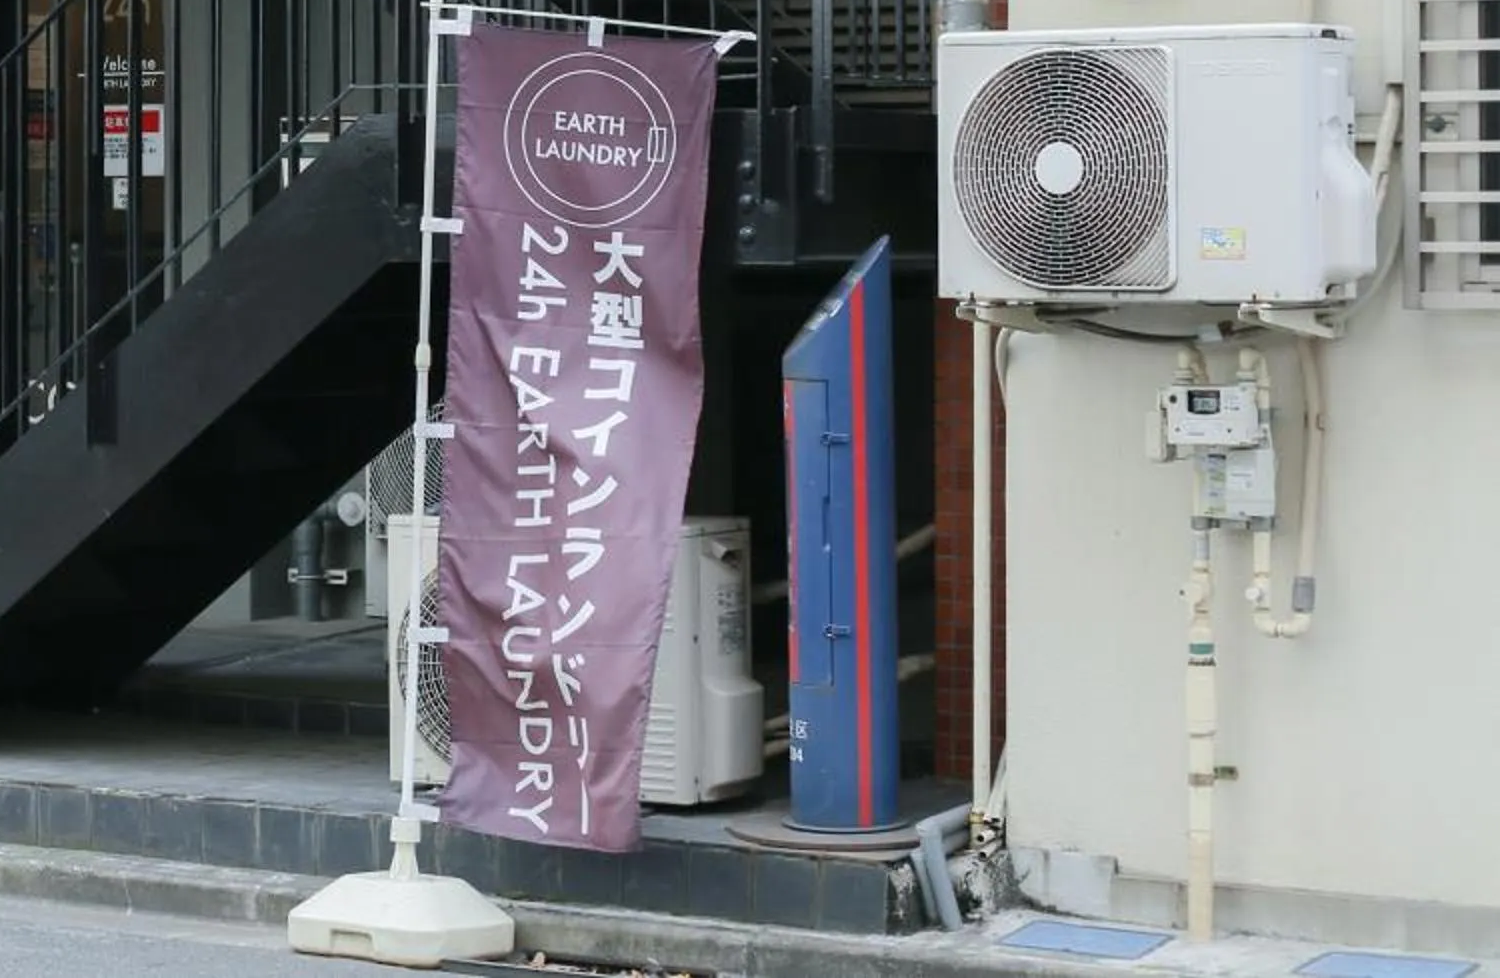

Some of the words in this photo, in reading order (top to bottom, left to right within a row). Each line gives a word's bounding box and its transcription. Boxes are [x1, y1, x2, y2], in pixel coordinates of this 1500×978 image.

[534, 137, 643, 168] LAUNDRY
[554, 110, 626, 137] EARTH
[517, 221, 569, 321] 24h
[508, 345, 562, 528] EARTH
[552, 231, 645, 836] 大型コインランドリー
[501, 553, 554, 836] LAUNDRY
